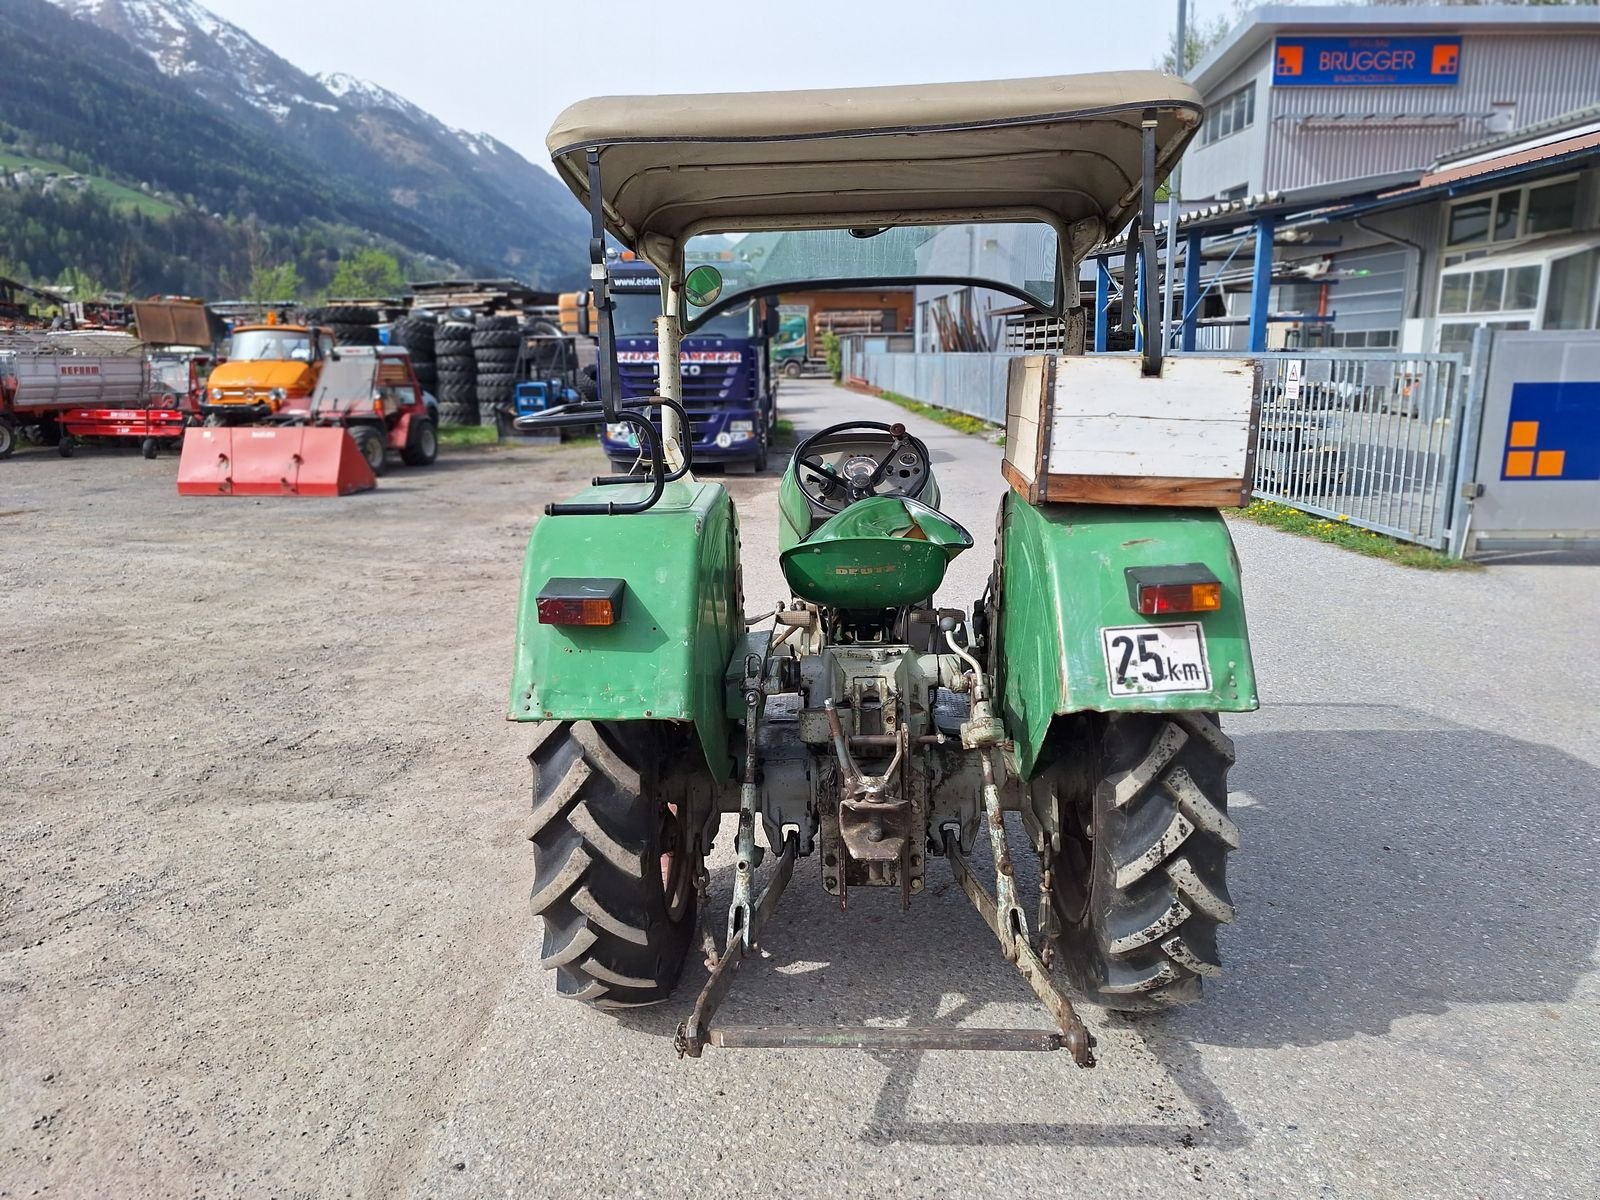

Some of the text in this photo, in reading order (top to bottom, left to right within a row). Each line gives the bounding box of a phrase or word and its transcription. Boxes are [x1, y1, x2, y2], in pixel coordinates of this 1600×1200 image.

[1319, 50, 1415, 70] BRUGGER
[616, 351, 742, 363] EIDEAMMER
[61, 366, 99, 376] REFORM
[653, 365, 701, 376] ICO
[1111, 634, 1201, 685] 25 km
